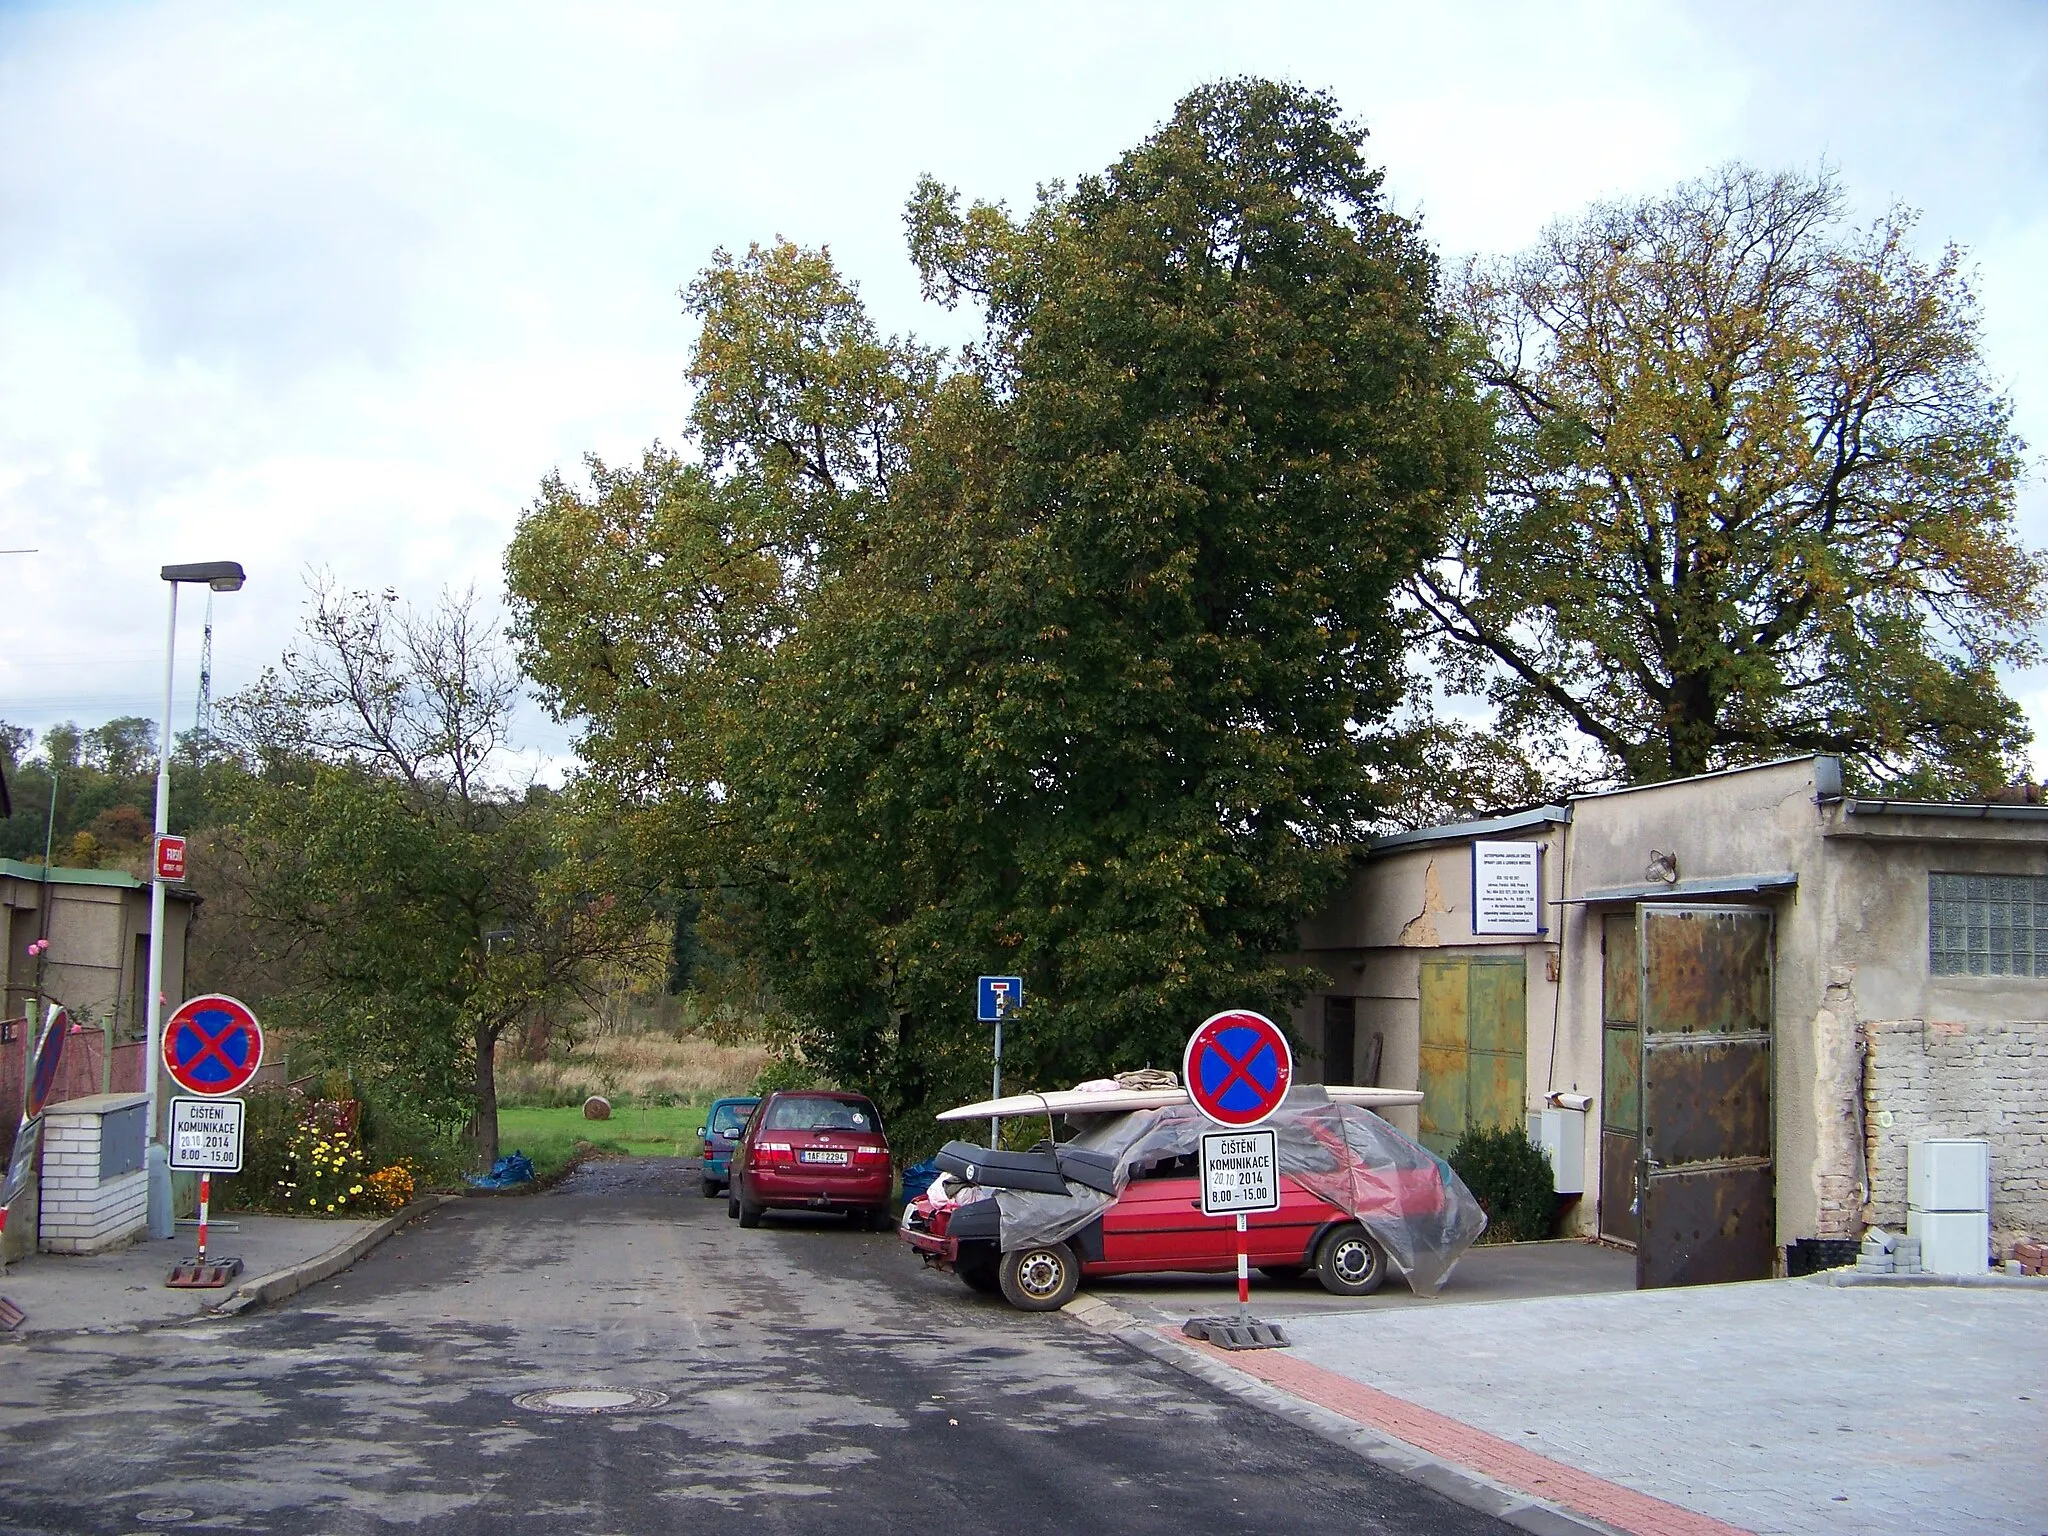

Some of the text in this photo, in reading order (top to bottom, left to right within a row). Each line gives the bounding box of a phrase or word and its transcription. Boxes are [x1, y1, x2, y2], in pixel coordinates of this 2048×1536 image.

[190, 1106, 224, 1119] ČIŠTĚNÍ
[178, 1121, 235, 1133] KOMUNIKACE
[1221, 1138, 1257, 1154] ČIŠTĚNÍ
[181, 1149, 200, 1160] 8.00
[1210, 1156, 1269, 1171] KOMUNIKACE
[1239, 1171, 1263, 1185] 2014
[1212, 1190, 1231, 1203] 8.00
[1243, 1187, 1267, 1200] 15.00
